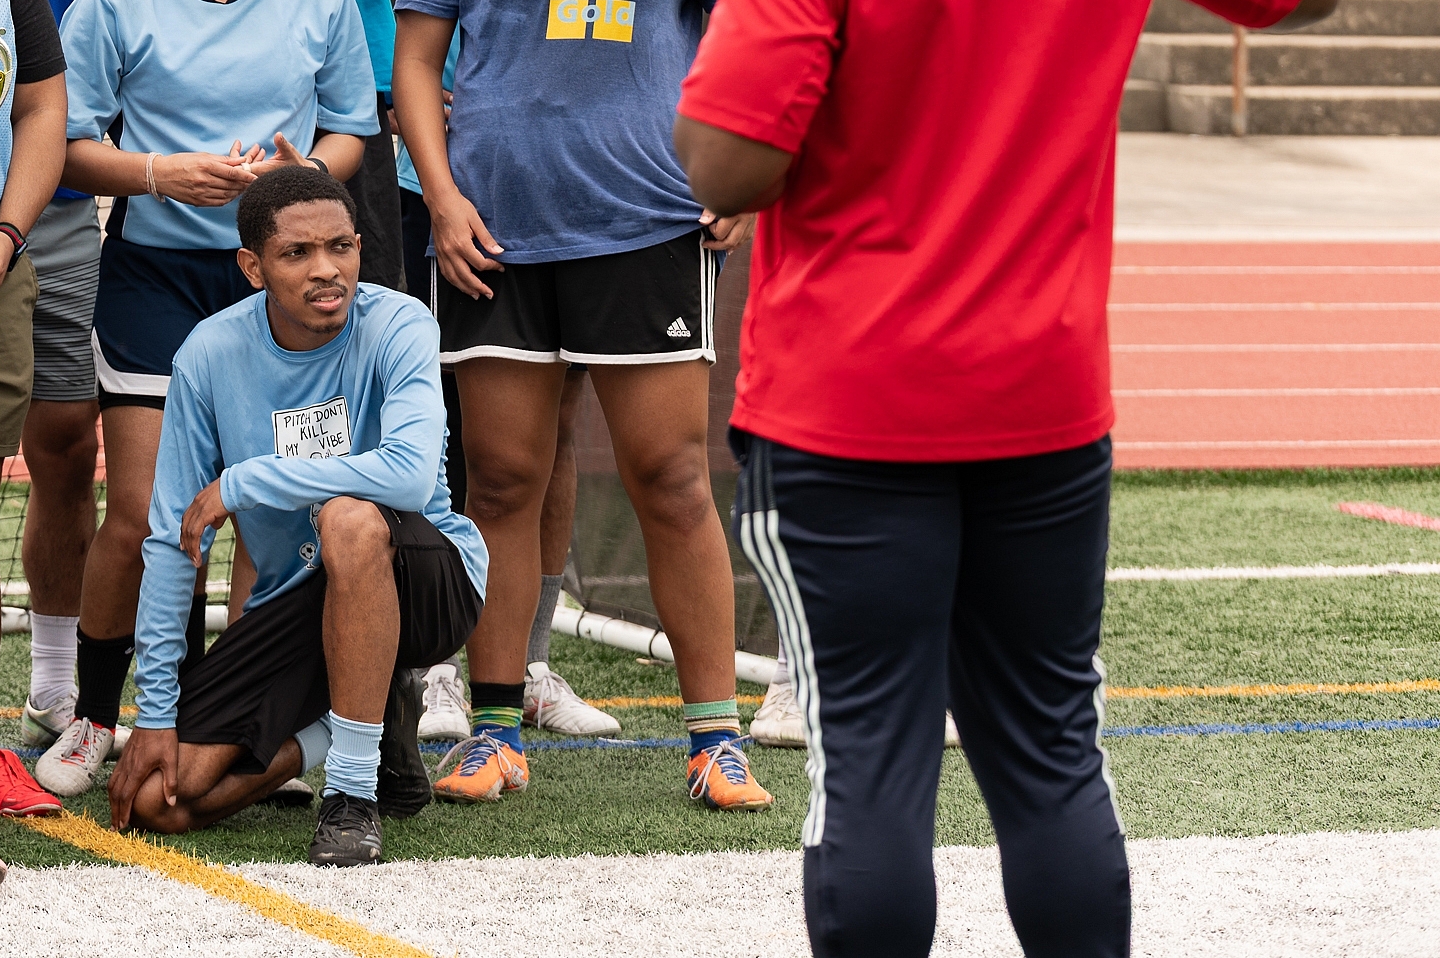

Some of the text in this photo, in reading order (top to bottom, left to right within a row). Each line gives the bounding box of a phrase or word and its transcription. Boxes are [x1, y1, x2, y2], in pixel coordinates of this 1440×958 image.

[283, 403, 343, 428] PITCH DONT
[285, 432, 344, 457] MY VIBE
[300, 423, 328, 441] KILL
